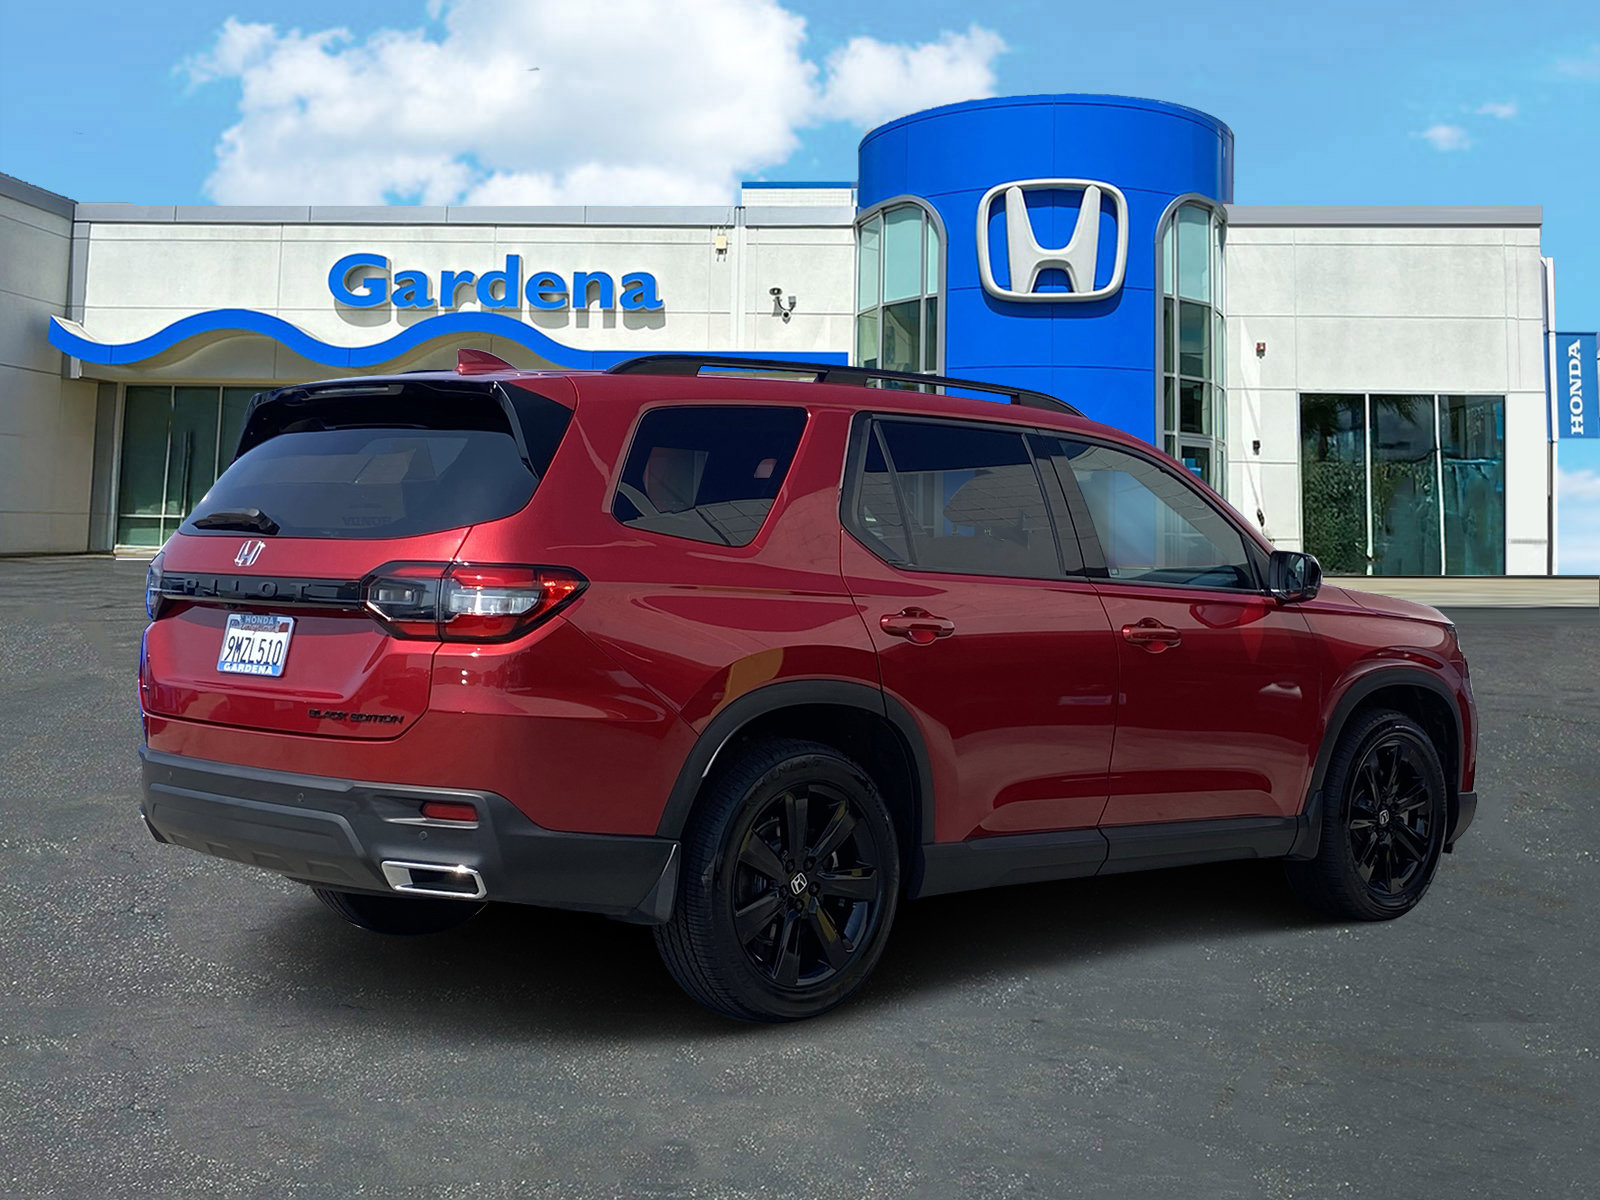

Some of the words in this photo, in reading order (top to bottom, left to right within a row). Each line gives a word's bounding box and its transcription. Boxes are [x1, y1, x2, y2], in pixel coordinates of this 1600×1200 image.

[328, 252, 664, 309] Gardena
[1568, 339, 1584, 435] HONDA
[183, 577, 312, 600] PILOT
[245, 615, 274, 625] HONDA
[224, 635, 283, 666] 9MZL510
[223, 663, 273, 675] GARDENA
